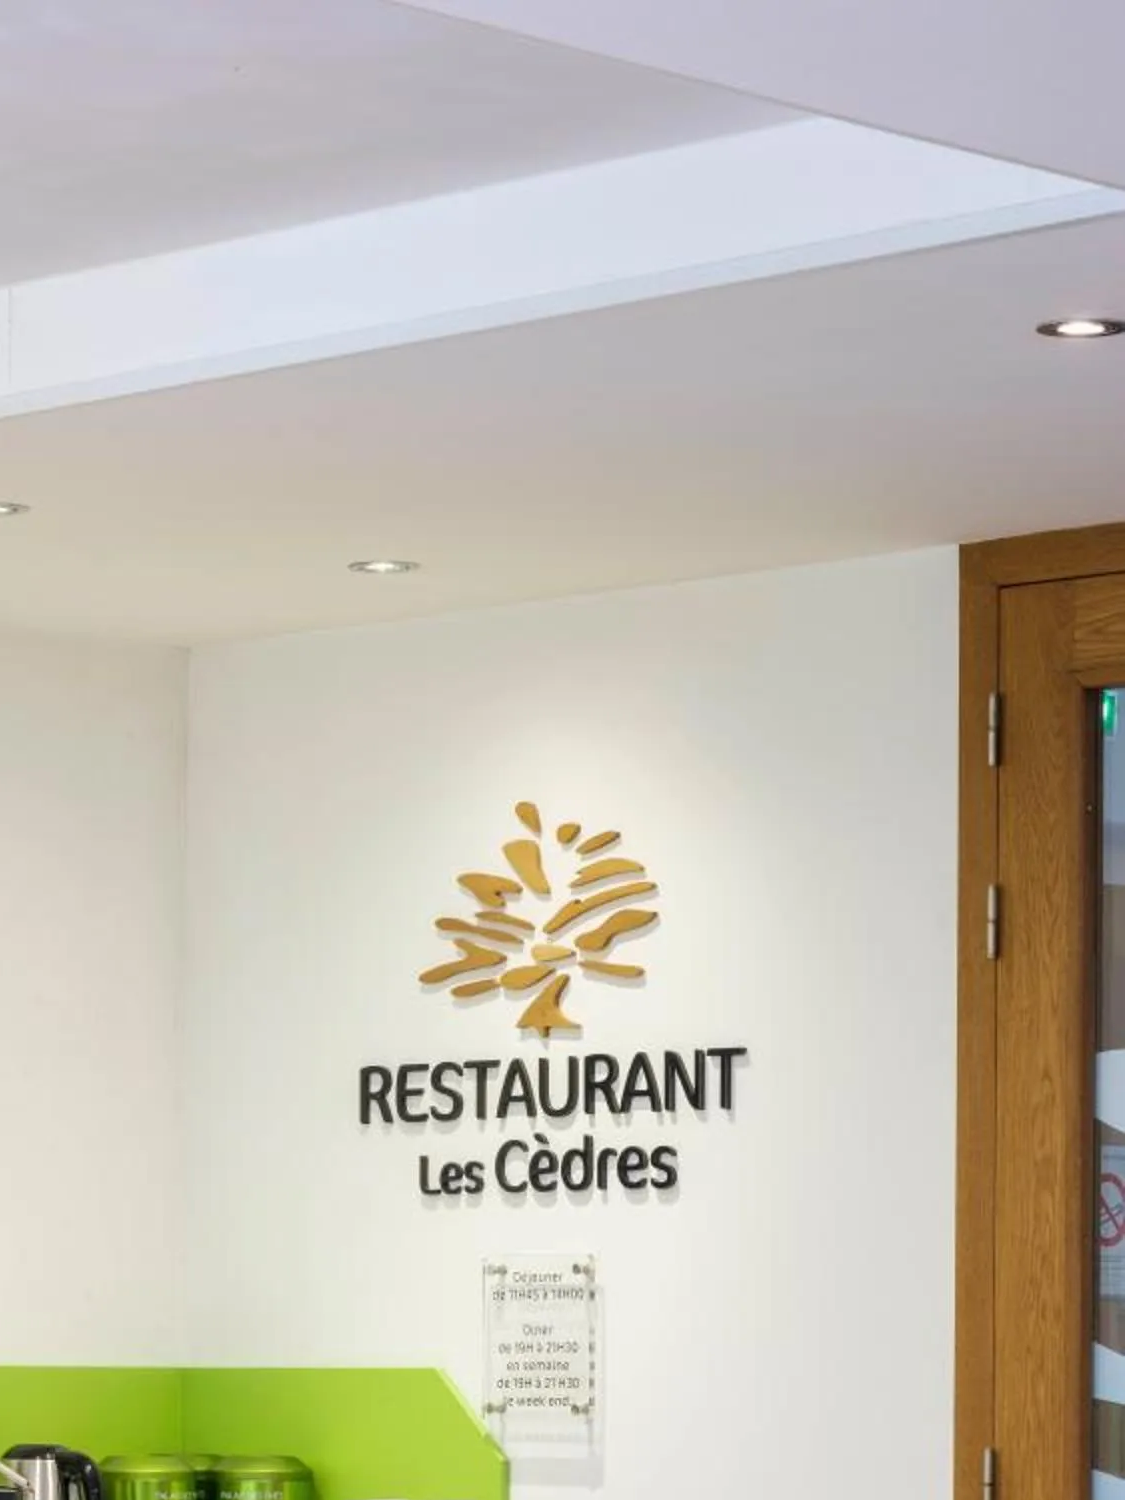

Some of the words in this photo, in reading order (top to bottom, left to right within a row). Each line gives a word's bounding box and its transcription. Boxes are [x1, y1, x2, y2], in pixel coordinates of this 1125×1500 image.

[359, 1047, 747, 1125] RESTAURANT
[419, 1155, 485, 1196] Les
[494, 1132, 679, 1194] Cèdres
